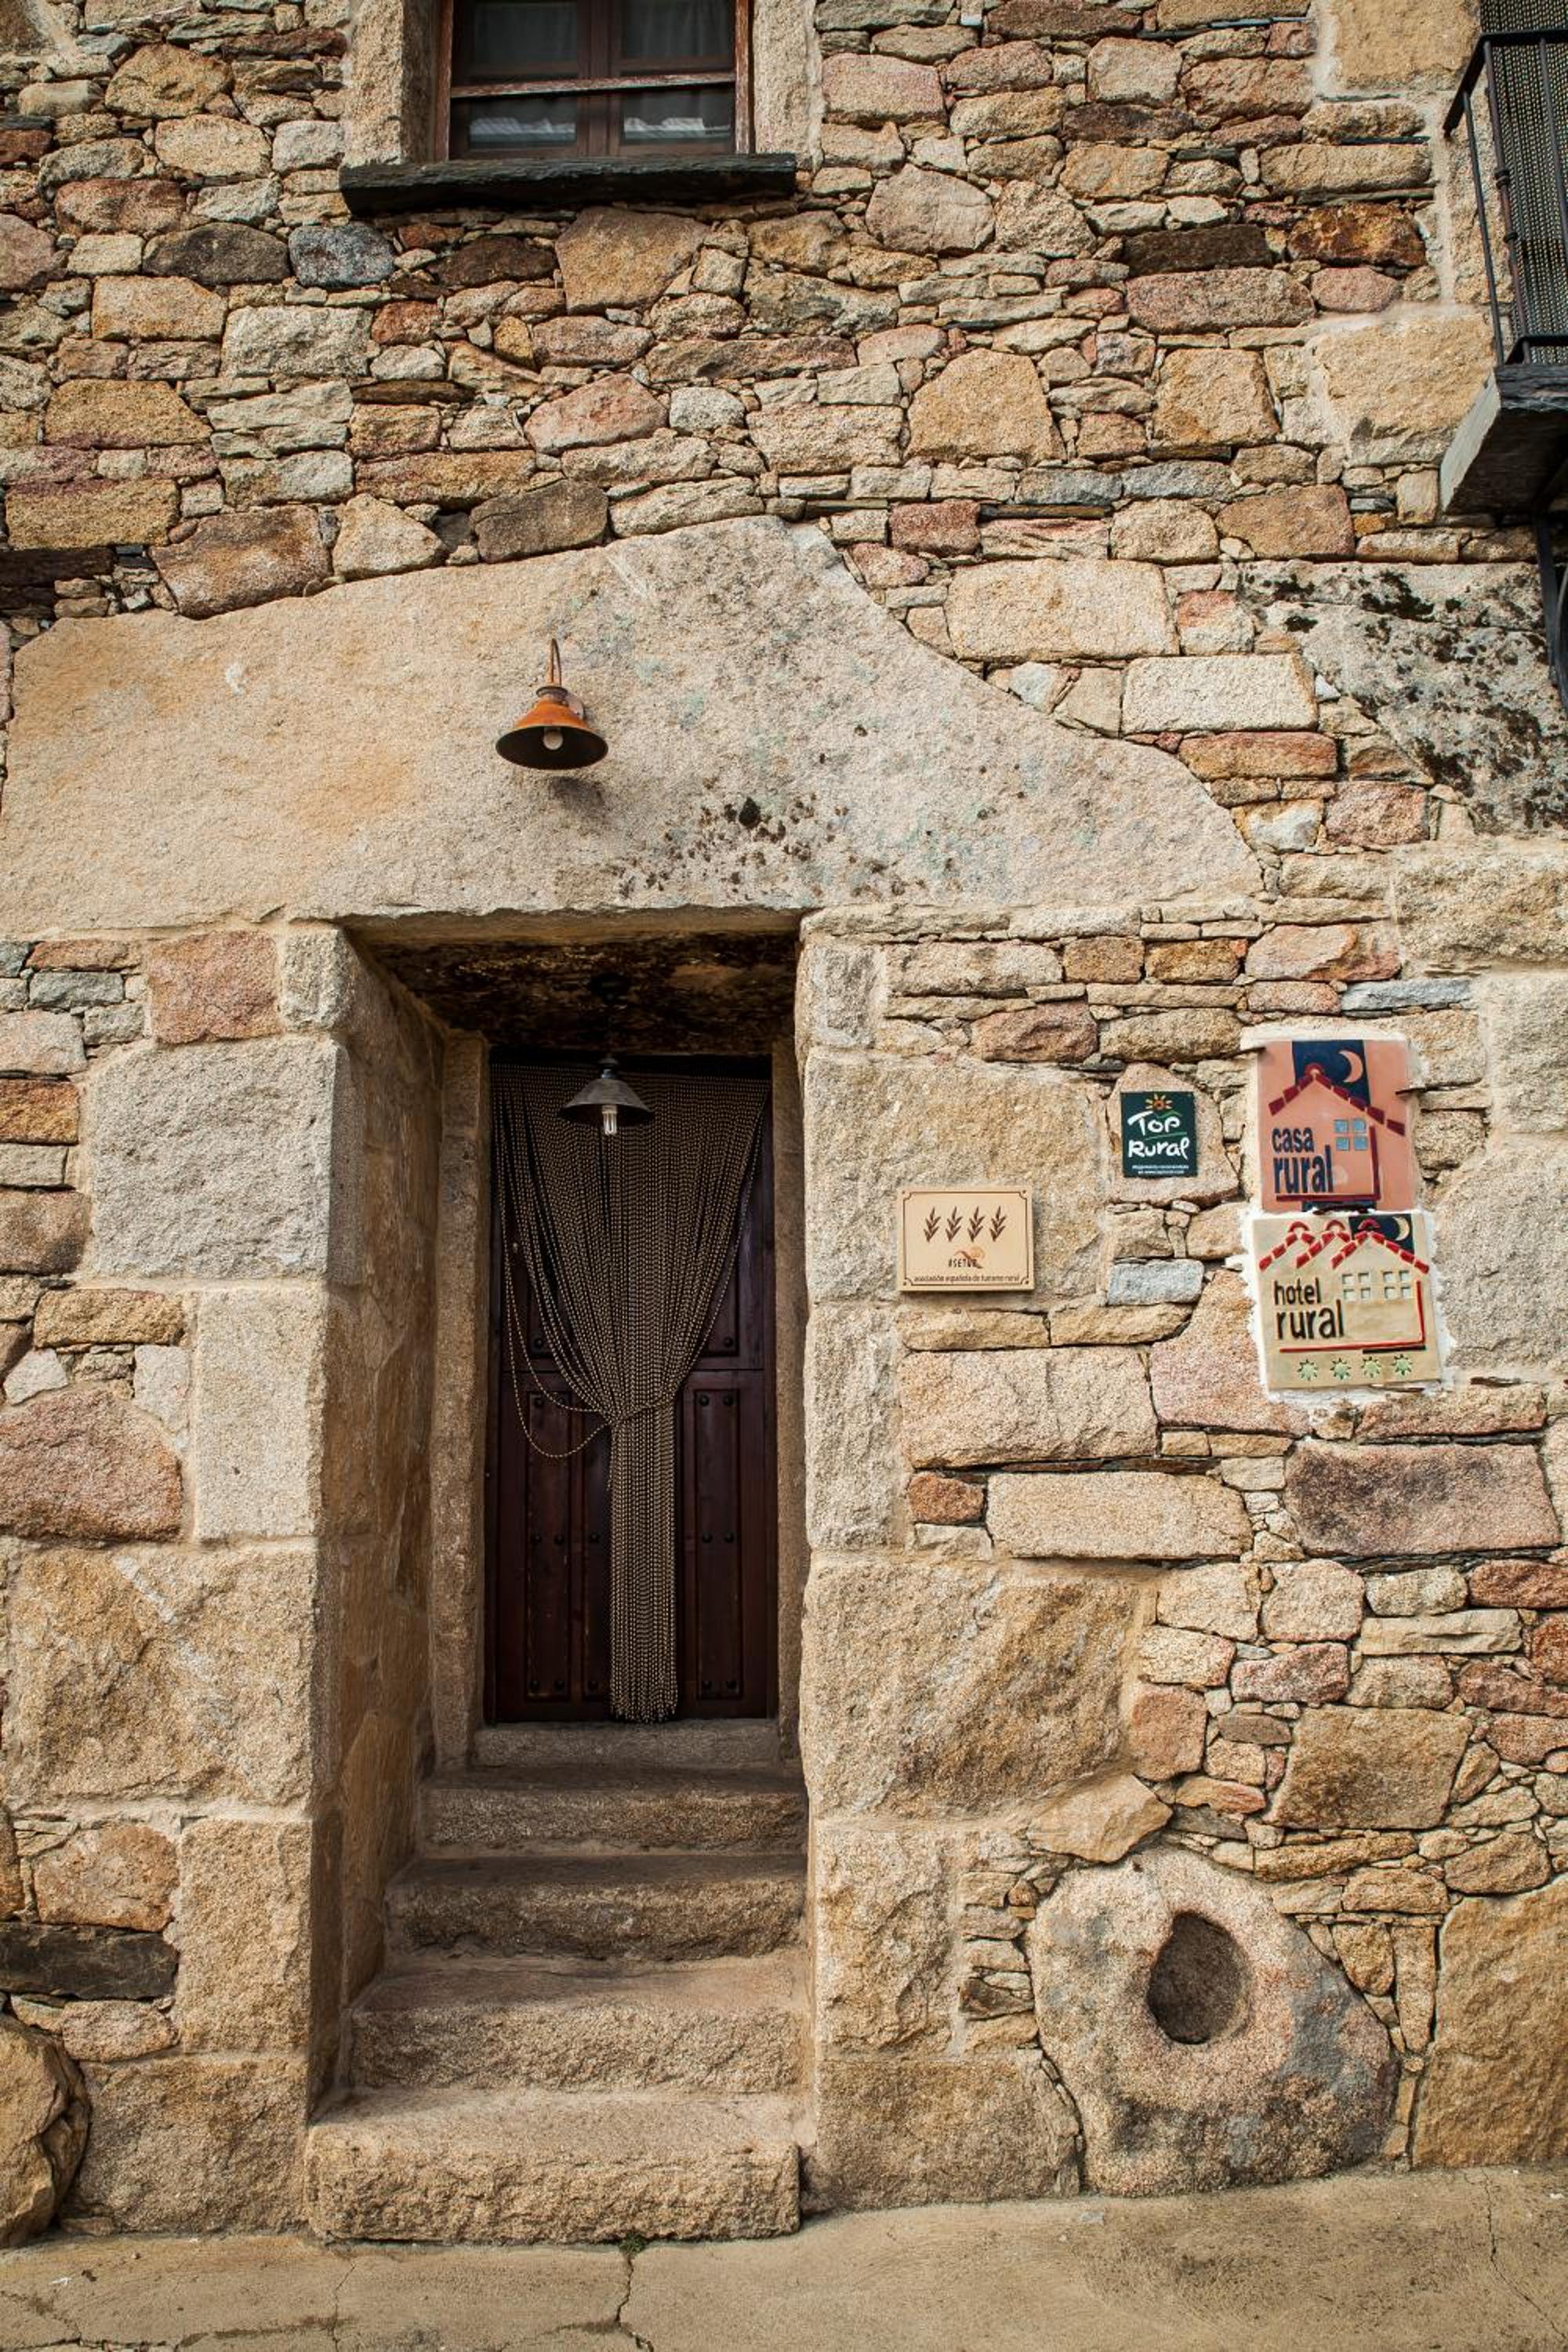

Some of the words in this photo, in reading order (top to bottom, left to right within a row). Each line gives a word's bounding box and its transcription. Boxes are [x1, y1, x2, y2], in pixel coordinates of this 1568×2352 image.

[1127, 1137, 1190, 1160] Rural
[1272, 1127, 1315, 1153] casa
[1273, 1145, 1333, 1193] rural
[1274, 1277, 1321, 1305] hotel
[1276, 1299, 1344, 1340] rural
